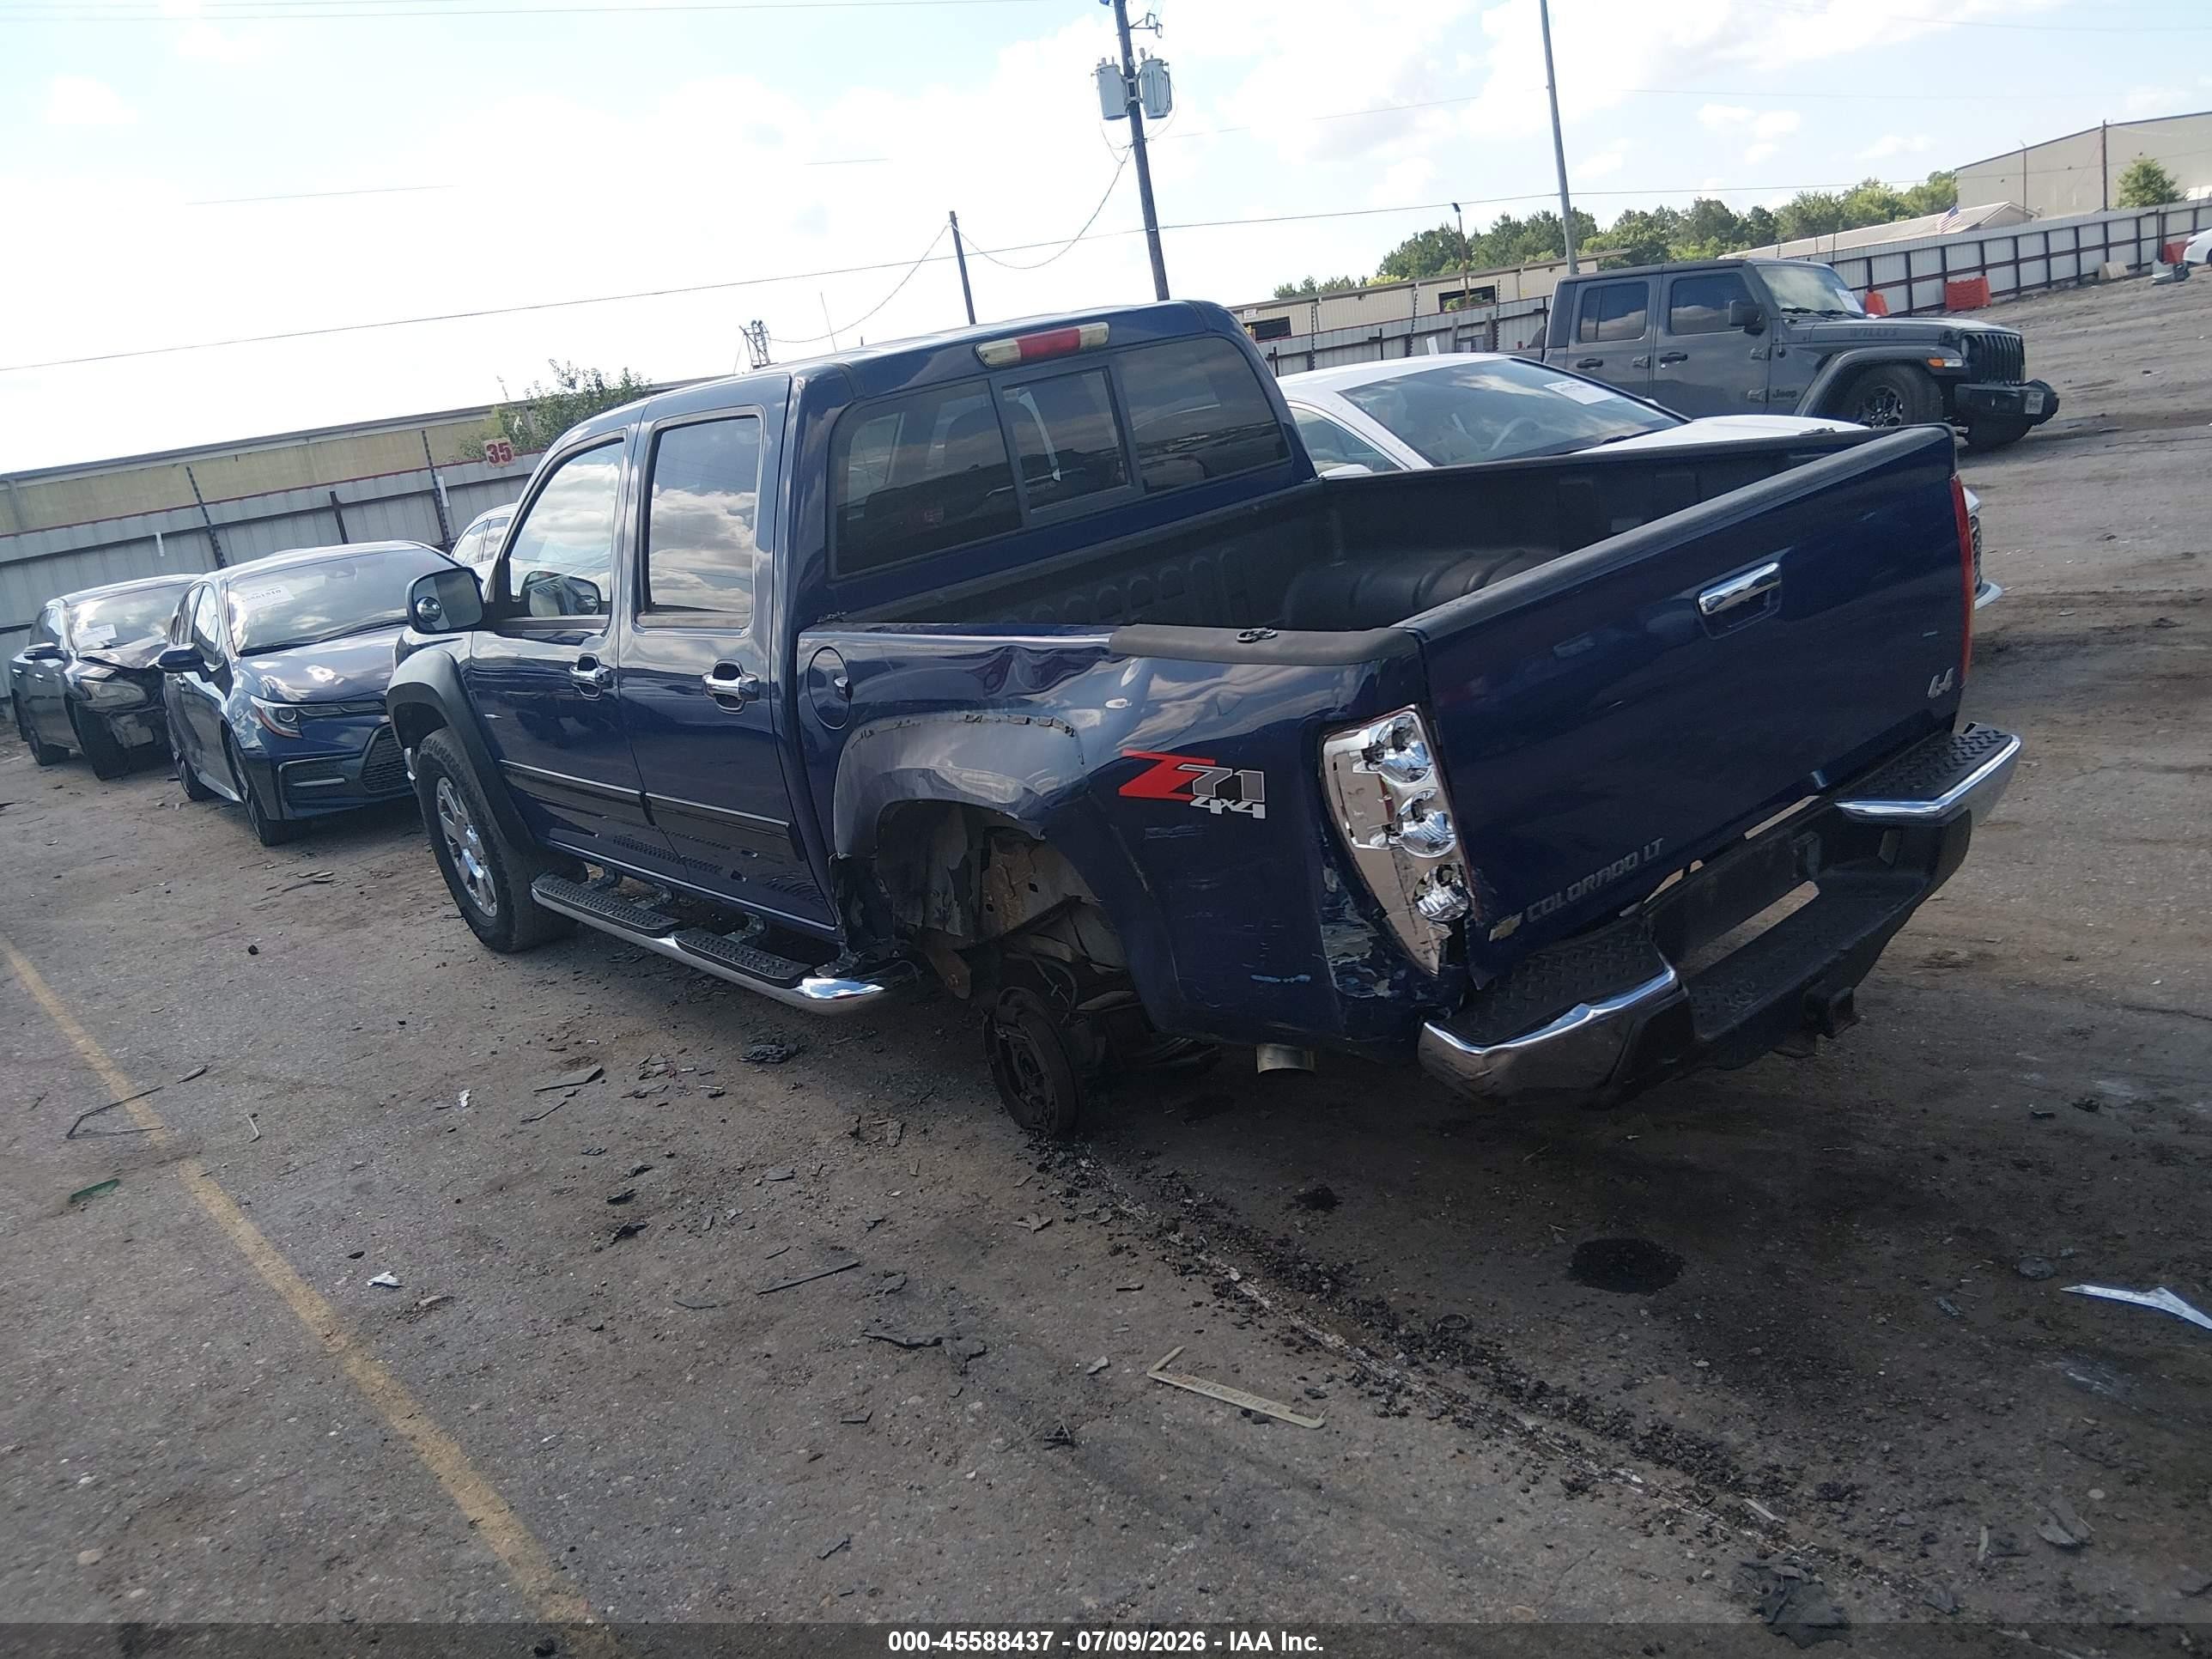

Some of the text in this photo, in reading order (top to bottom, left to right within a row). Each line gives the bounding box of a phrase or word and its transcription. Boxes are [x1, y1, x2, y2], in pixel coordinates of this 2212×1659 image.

[486, 442, 514, 464] 35
[1118, 749, 1266, 803] Z71
[1526, 837, 1663, 923] COLORADO LT
